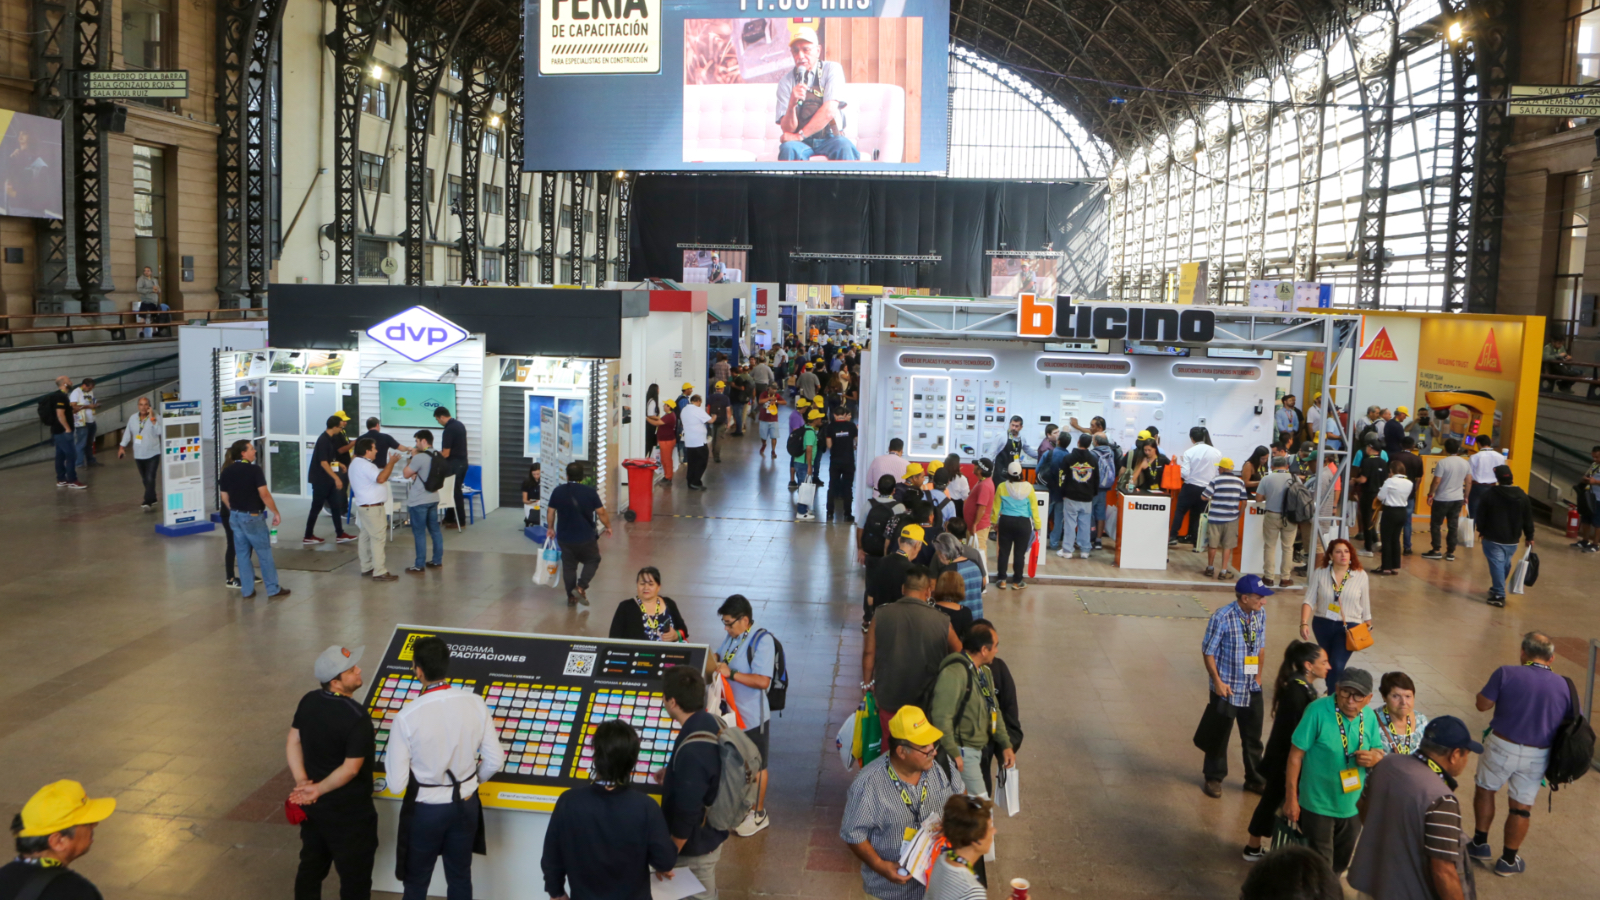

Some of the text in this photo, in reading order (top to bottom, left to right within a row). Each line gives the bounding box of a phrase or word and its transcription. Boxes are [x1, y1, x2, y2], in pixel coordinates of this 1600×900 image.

[552, 19, 649, 38] DE CAPACITACIÓN
[551, 57, 564, 65] PARA
[565, 57, 602, 65] ESPECIALISTAS
[610, 55, 648, 64] CONSTRUCCIÓN
[93, 81, 175, 89] SALA GONZALO ROJAS
[1538, 87, 1560, 95] SALA
[1519, 106, 1598, 116] SALA FERNANDO
[1018, 293, 1215, 342] bticino
[385, 322, 448, 346] dvp
[1365, 338, 1393, 358] Sika
[1478, 343, 1497, 368] Sika
[1437, 357, 1470, 368] BUILDING TRUST
[1419, 379, 1432, 390] PARA
[423, 400, 440, 408] dvp
[1128, 501, 1166, 511] bticino
[446, 643, 495, 654] ROGRAMA
[449, 651, 527, 663] PACITACIONES
